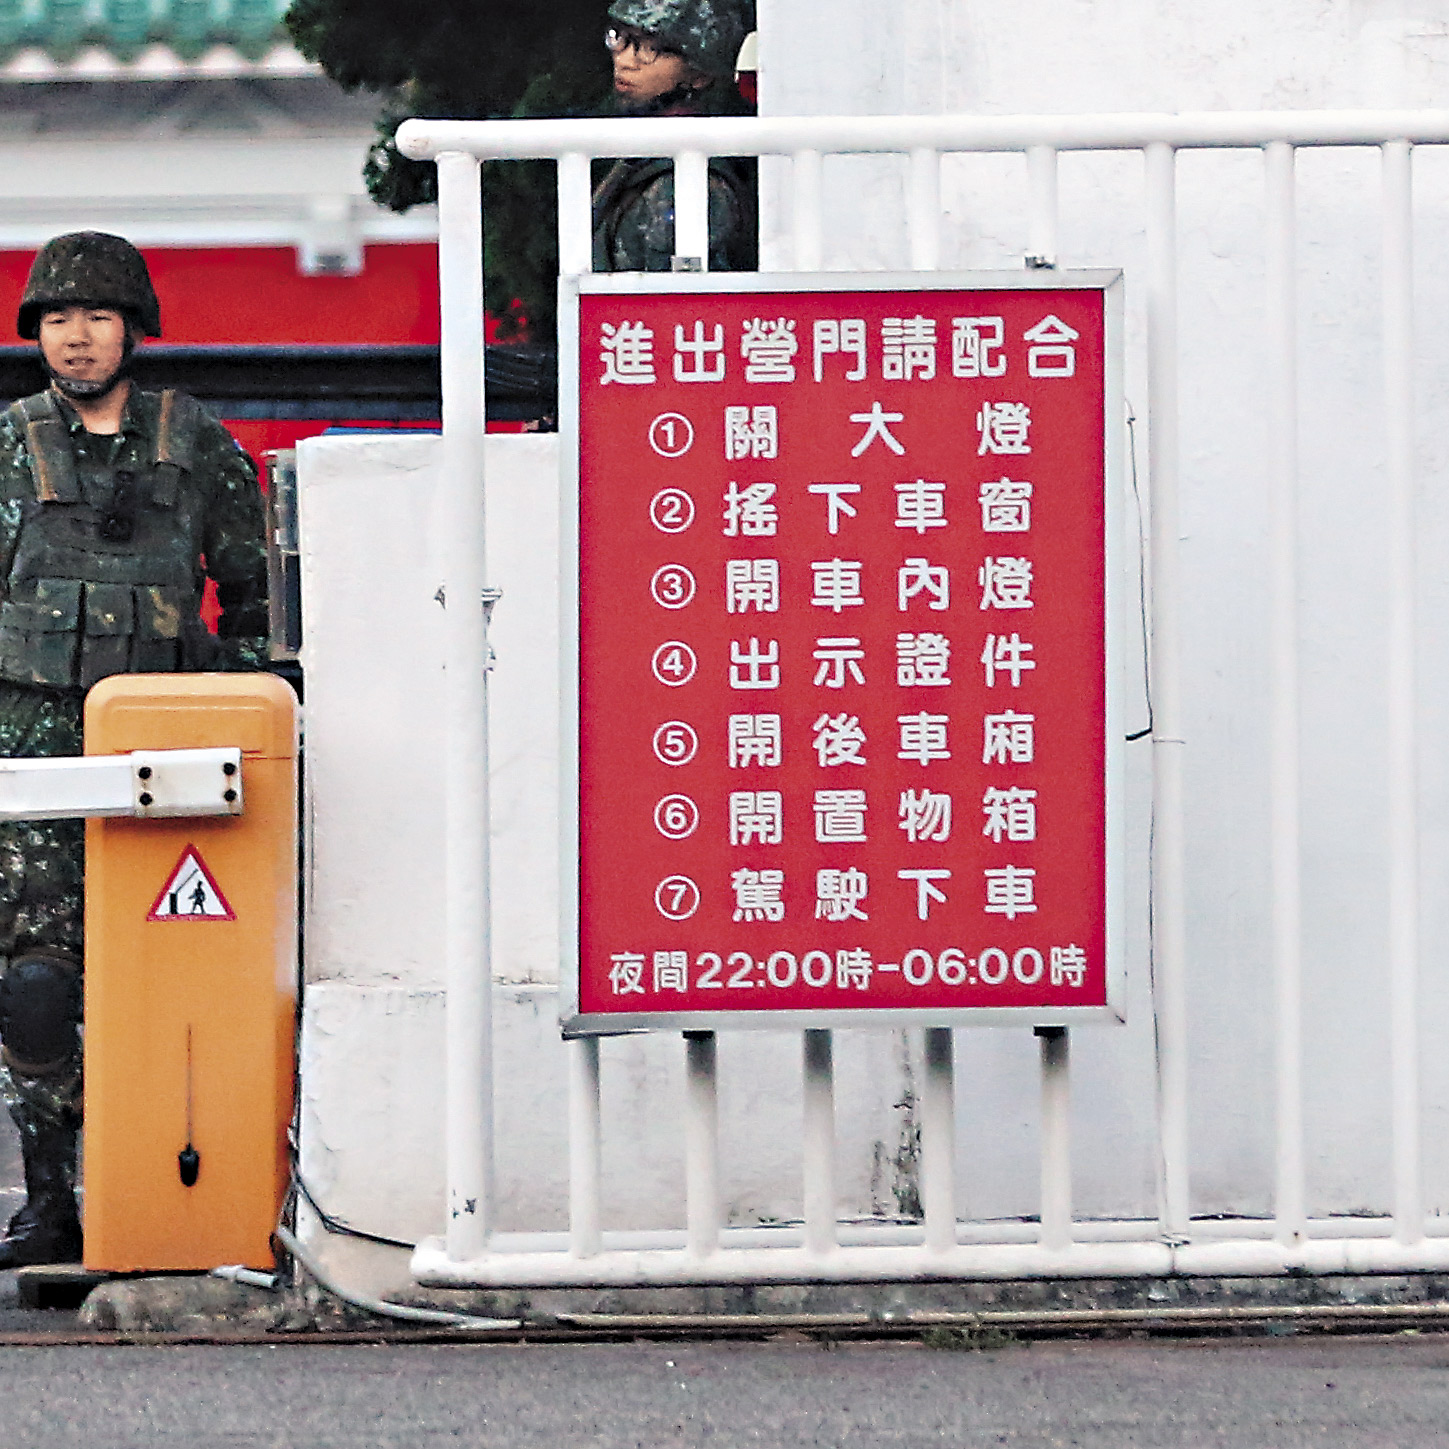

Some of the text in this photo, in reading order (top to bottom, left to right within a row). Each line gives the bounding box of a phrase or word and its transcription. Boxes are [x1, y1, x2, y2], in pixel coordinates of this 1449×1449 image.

[598, 314, 1080, 386] 進出營門請配合
[607, 943, 1089, 995] 夜間22:00時-06:00時
